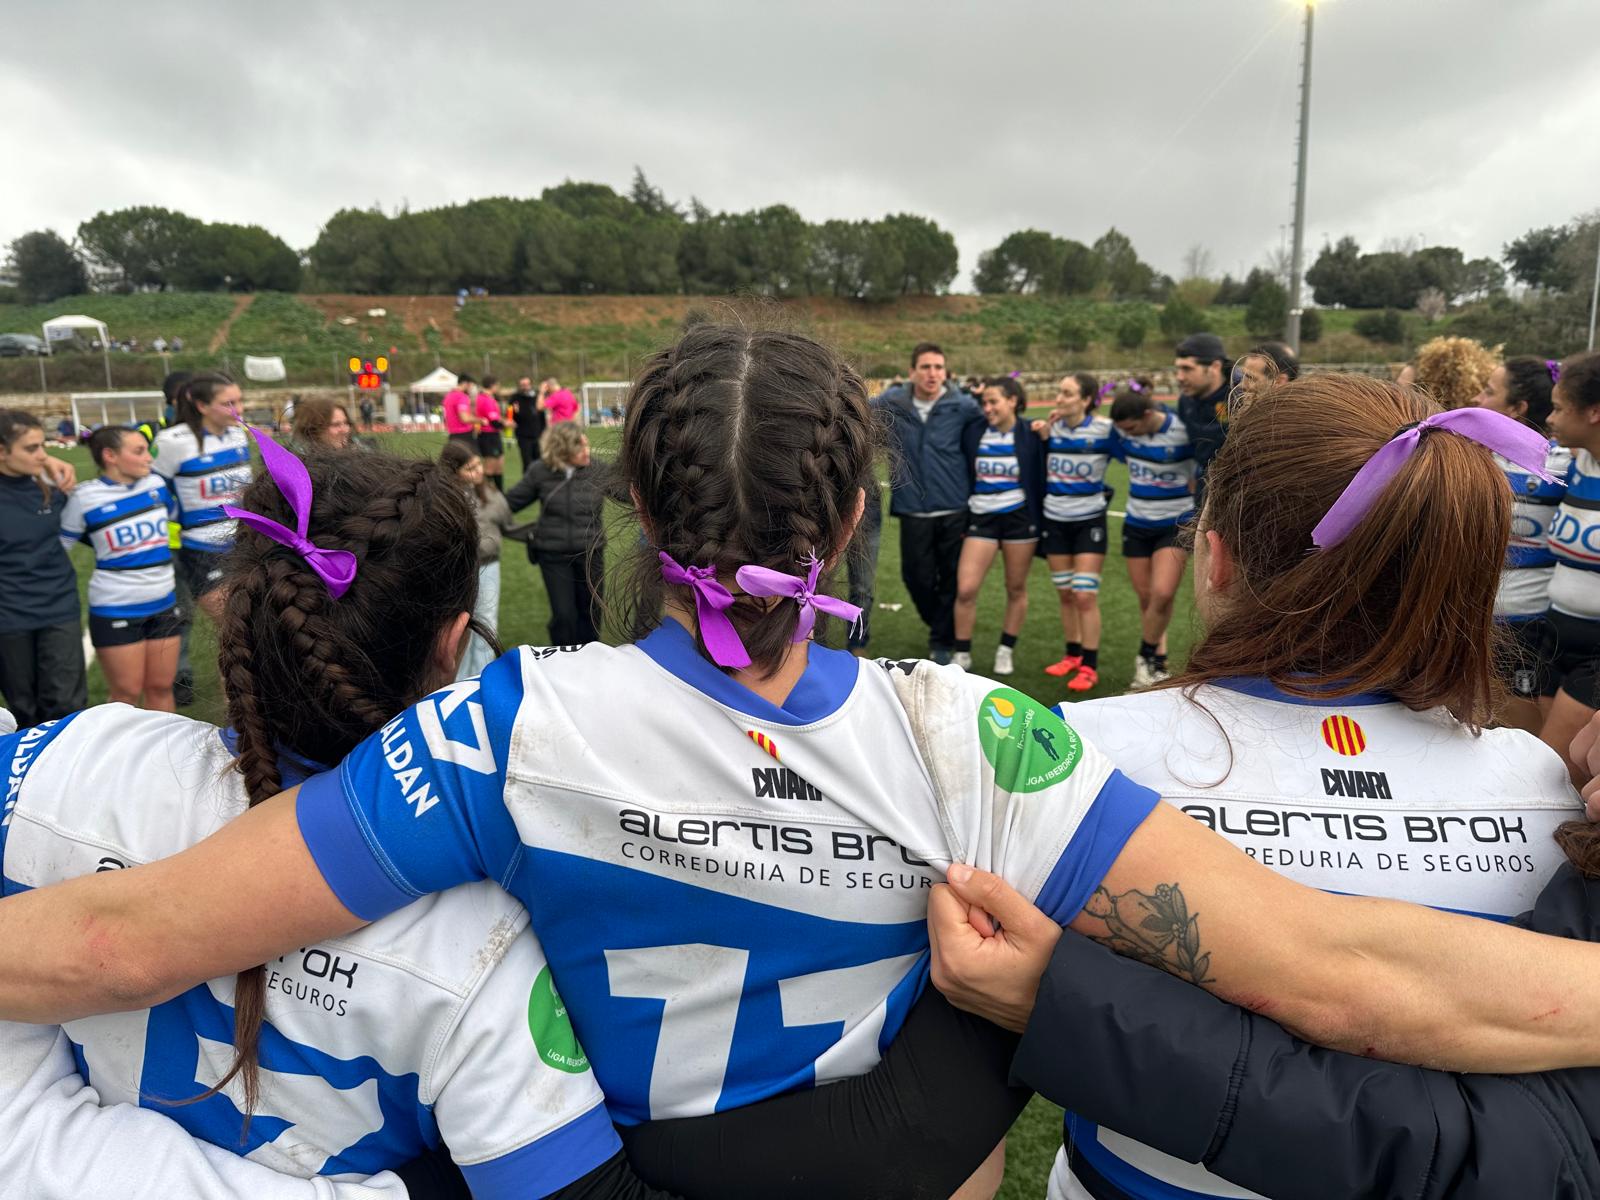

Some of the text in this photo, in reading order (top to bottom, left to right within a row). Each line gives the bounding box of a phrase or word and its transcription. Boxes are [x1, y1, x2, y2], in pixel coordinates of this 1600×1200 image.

[1049, 456, 1092, 478] BDO
[1129, 463, 1178, 483] BDO
[380, 713, 440, 818] ALDAN
[621, 842, 948, 890] CORREDURIA DE SEGUR
[1377, 853, 1409, 871] DE
[1423, 854, 1535, 873] SEGUROS
[264, 966, 347, 1017] EGUROS
[547, 1048, 565, 1064] LIGA
